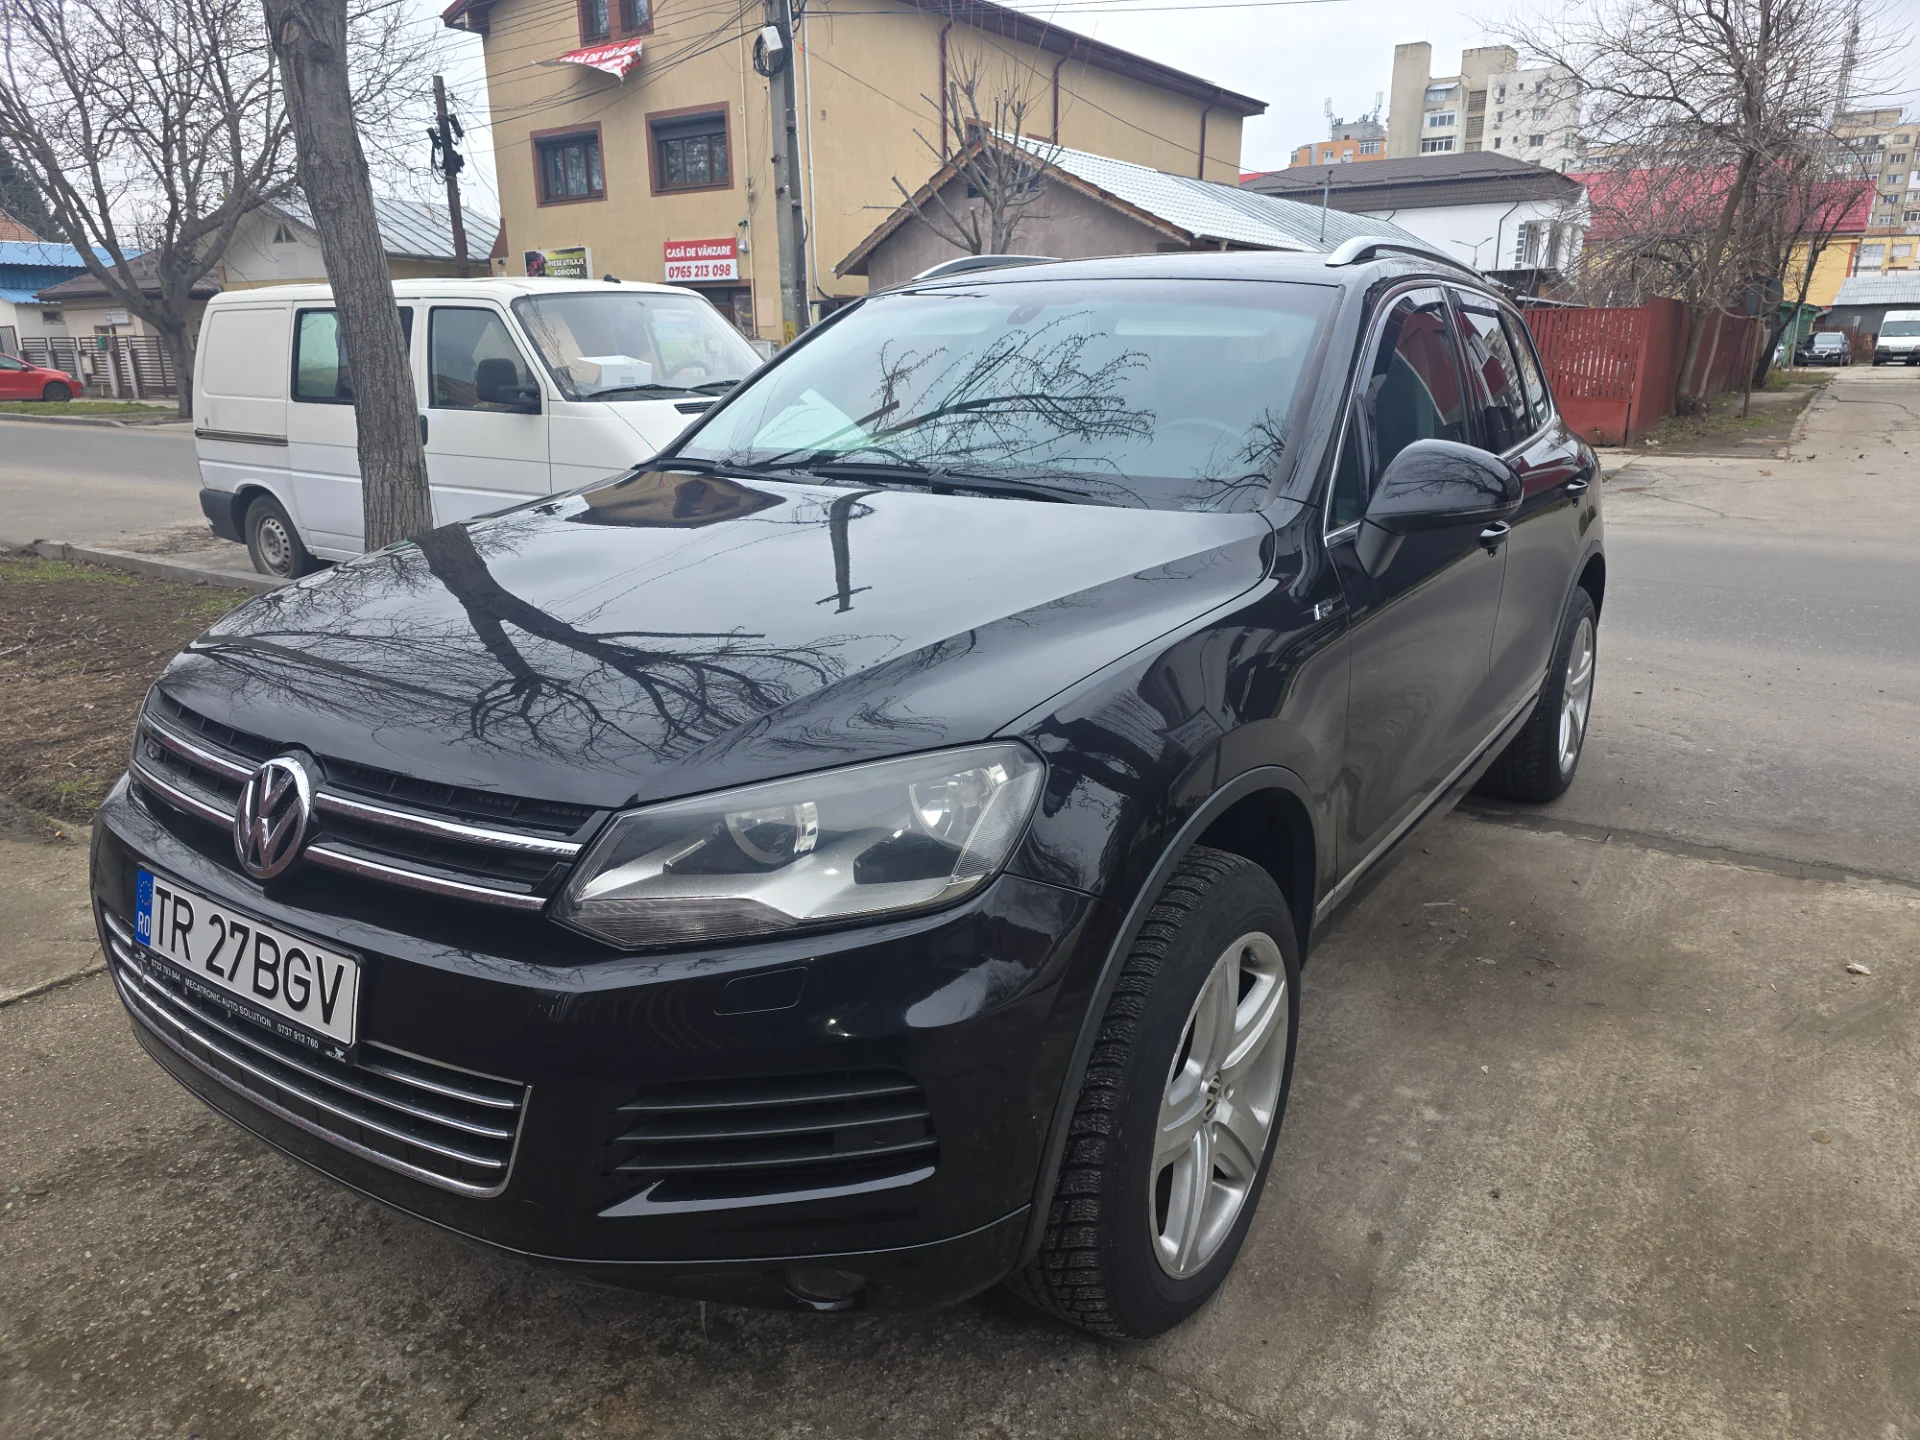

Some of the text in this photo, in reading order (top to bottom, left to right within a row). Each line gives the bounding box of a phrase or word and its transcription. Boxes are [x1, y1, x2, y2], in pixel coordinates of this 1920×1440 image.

[666, 244, 731, 258] CASĂ DE VÂNZARE
[668, 263, 731, 279] 0765 213 098
[138, 911, 150, 937] RO
[156, 885, 195, 962] TR
[185, 977, 221, 1003] MECATRONIC
[222, 998, 238, 1012] AUTO
[239, 1005, 272, 1028] SOLUTION
[277, 1023, 293, 1037] 0737
